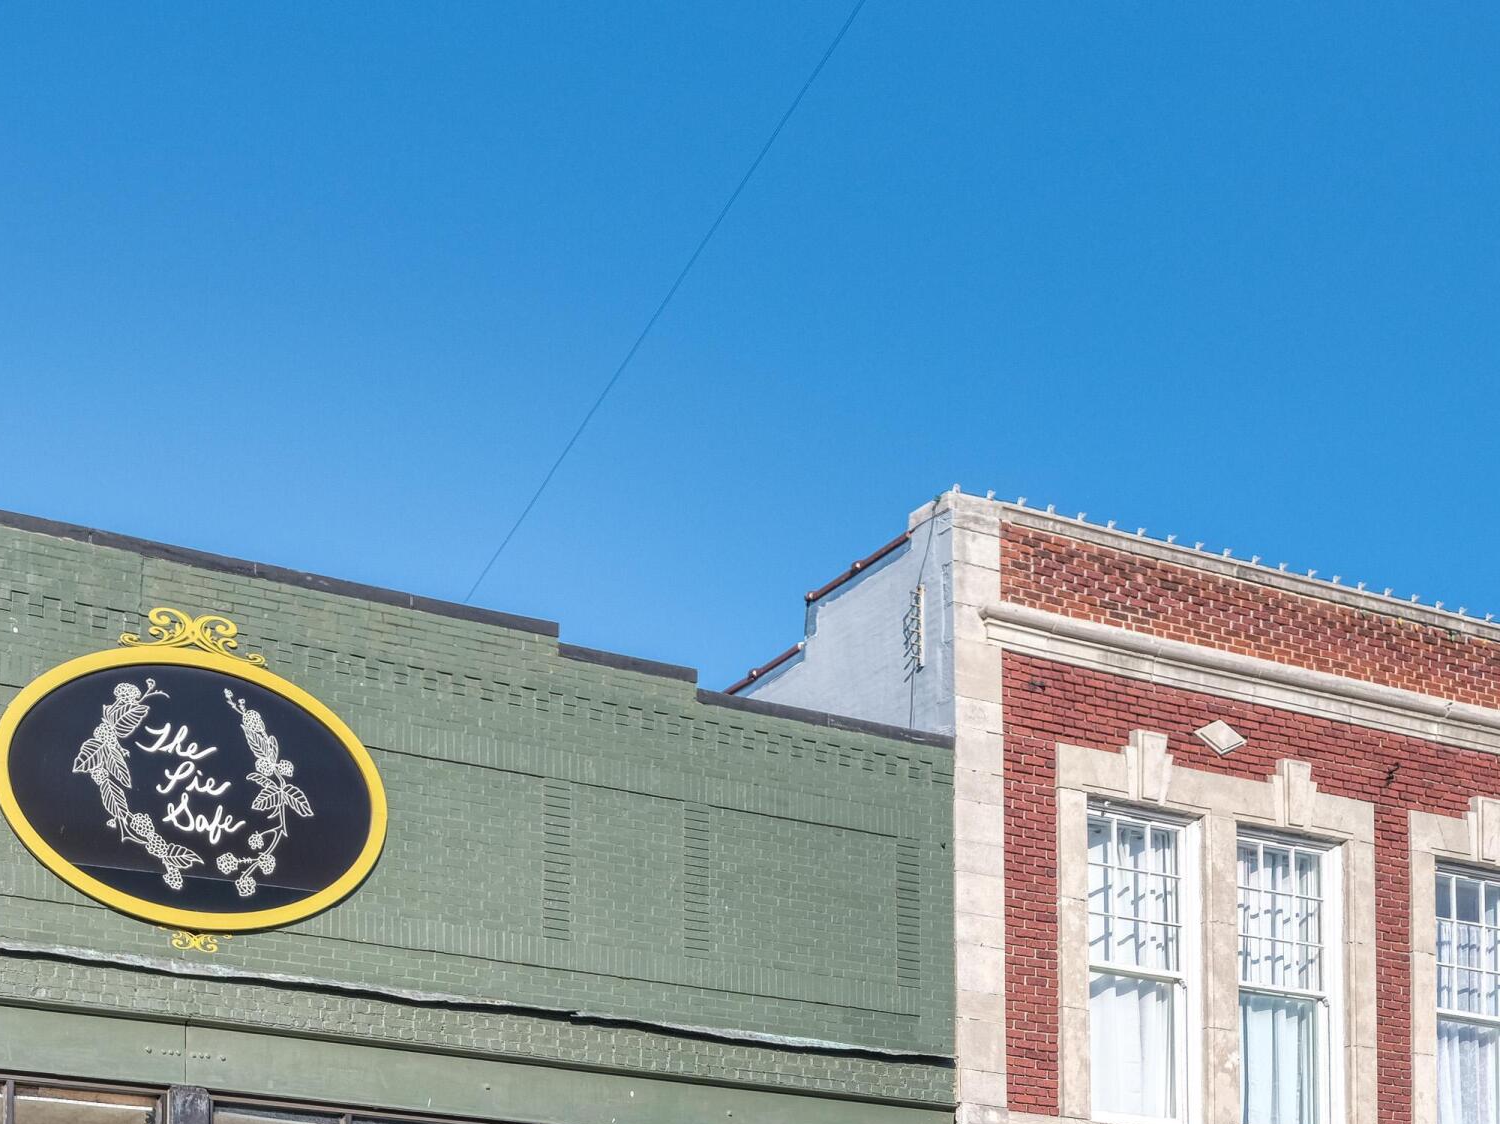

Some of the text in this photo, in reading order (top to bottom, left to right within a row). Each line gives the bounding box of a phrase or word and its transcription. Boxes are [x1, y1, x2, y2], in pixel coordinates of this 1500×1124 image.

[135, 722, 217, 759] The
[156, 761, 231, 795] Pie
[162, 792, 246, 844] Safe
